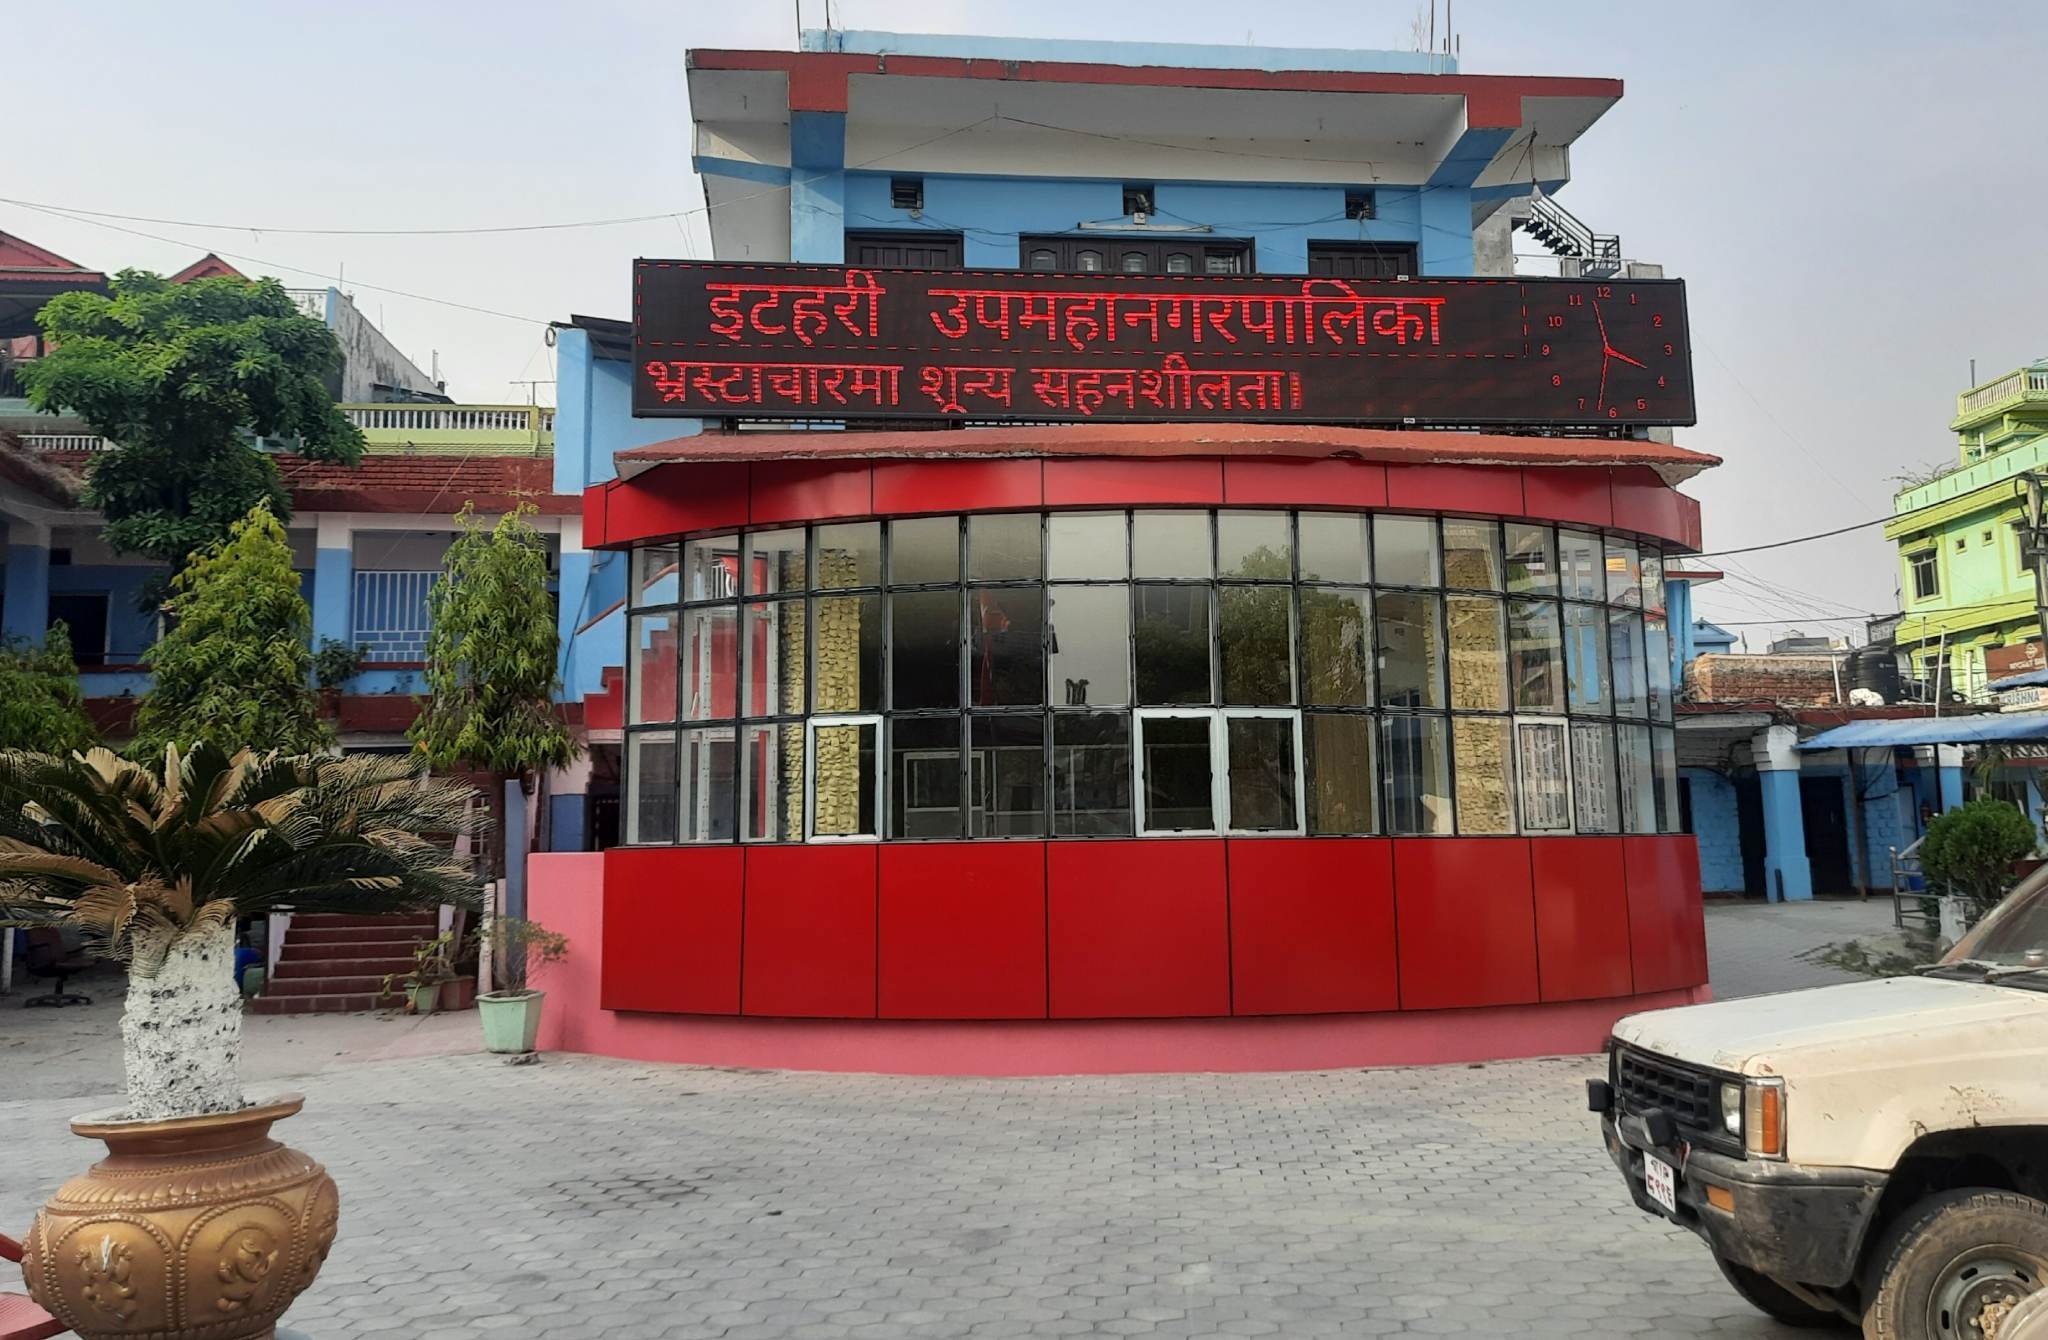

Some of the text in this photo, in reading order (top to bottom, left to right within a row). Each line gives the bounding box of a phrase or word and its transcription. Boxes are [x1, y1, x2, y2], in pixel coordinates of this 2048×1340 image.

[1596, 286, 1611, 298] 12
[1568, 294, 1583, 306] 11
[1630, 293, 1638, 304] 1
[706, 269, 1447, 351] इटहरी उपमहानगरपालिका
[1548, 316, 1563, 327] 10
[1653, 316, 1662, 327] 2
[1541, 344, 1550, 356] 9
[1664, 344, 1673, 356] 3
[1552, 375, 1561, 386] 8
[1657, 375, 1665, 387] 4
[1578, 398, 1585, 409] 7
[1637, 399, 1646, 410] 5
[1609, 407, 1617, 418] 6
